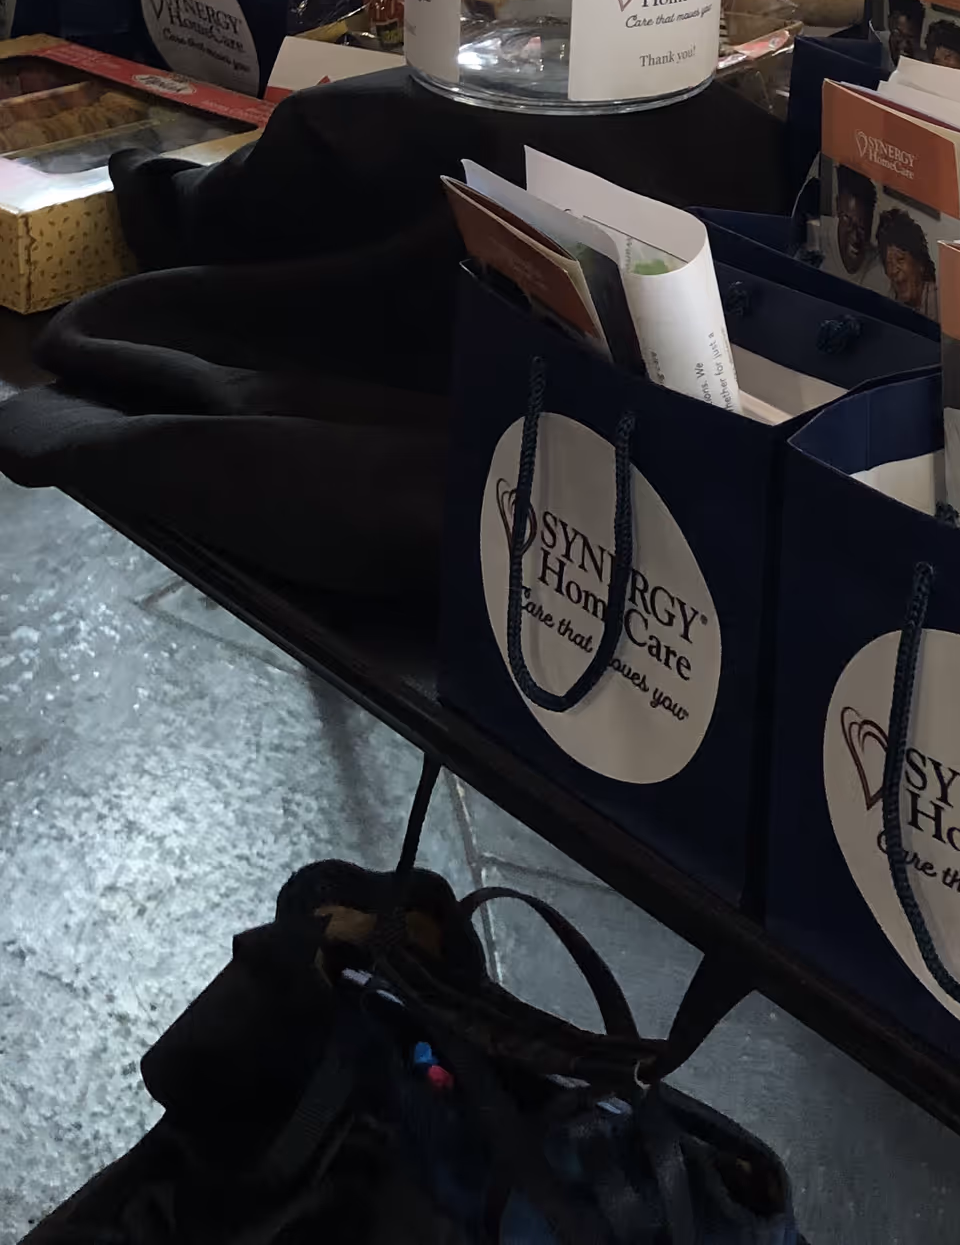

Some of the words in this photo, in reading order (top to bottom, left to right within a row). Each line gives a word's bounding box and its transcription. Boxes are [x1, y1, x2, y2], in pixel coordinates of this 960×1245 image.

[625, 14, 654, 28] Care
[655, 13, 675, 25] that
[639, 51, 675, 67] Thank
[676, 43, 696, 64] you!
[868, 136, 915, 168] SYNERGY
[868, 149, 914, 179] HomeCare
[709, 340, 721, 360] just
[695, 362, 705, 379] We
[714, 361, 723, 376] for
[720, 378, 734, 412] hether
[537, 547, 692, 681] HomCare
[556, 618, 594, 653] that
[608, 658, 649, 692] oves
[650, 686, 686, 721] you
